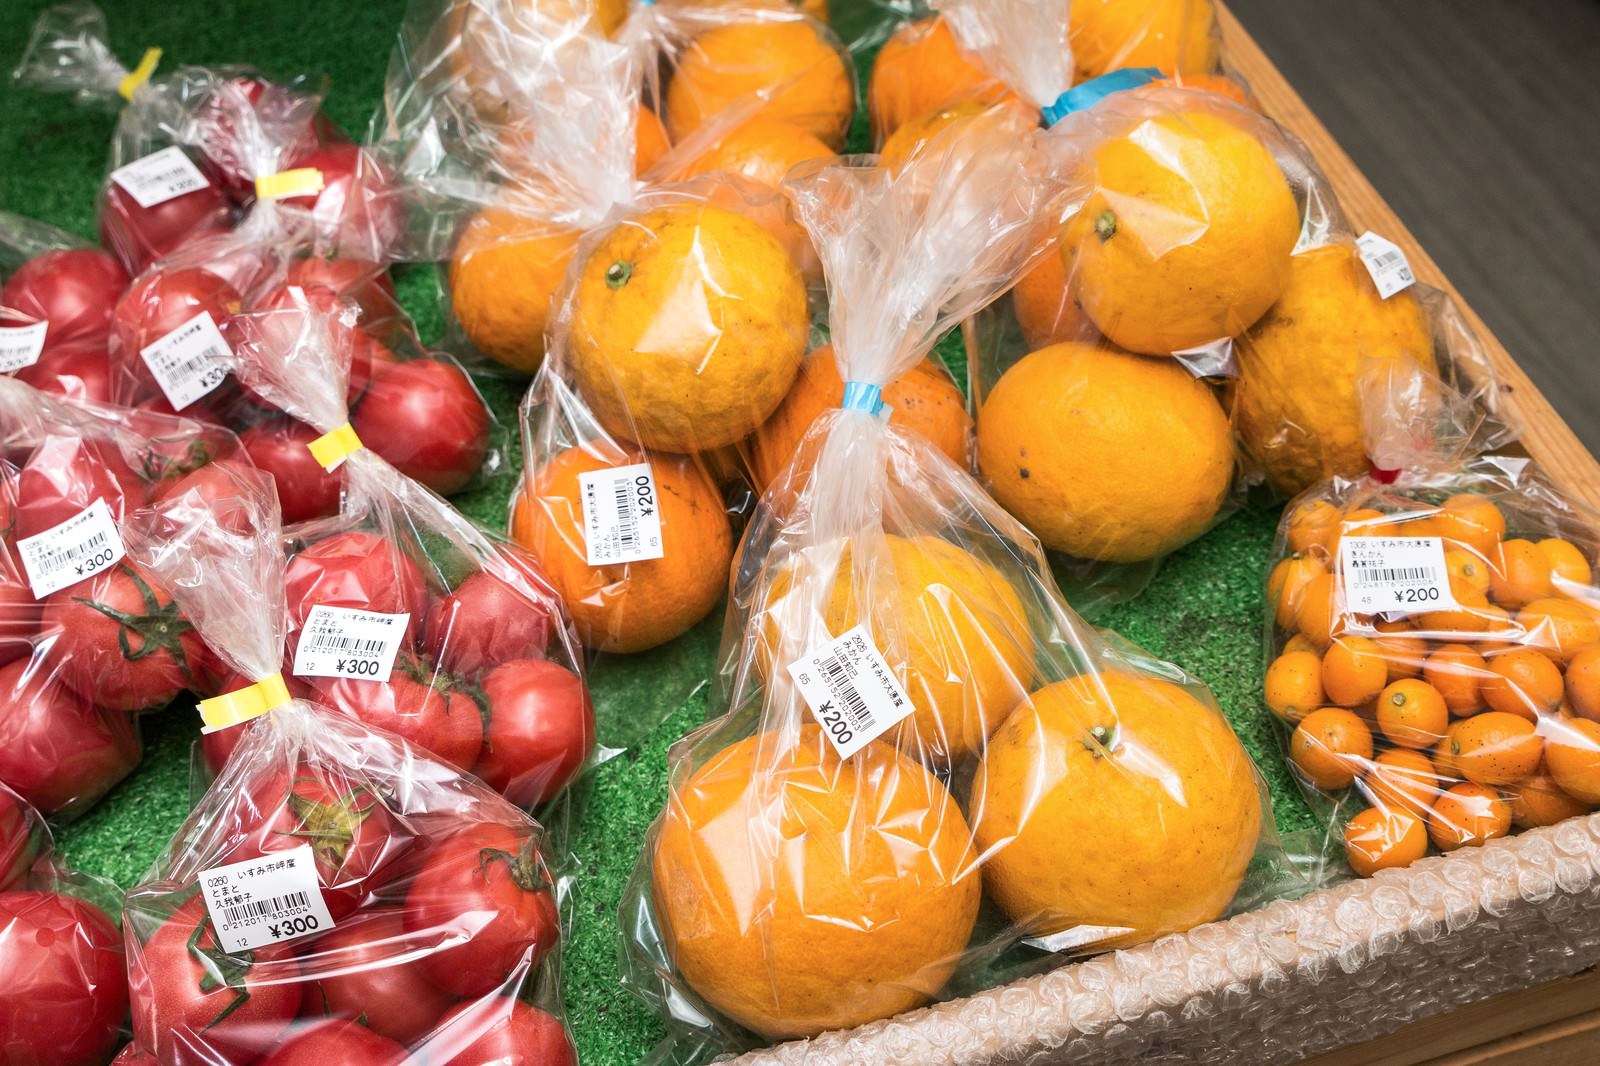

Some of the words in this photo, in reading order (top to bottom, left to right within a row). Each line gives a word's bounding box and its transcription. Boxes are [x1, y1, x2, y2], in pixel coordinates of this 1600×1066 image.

[635, 476, 653, 517] ¥200
[603, 534, 611, 558] みかん
[650, 537, 658, 546] 65
[75, 548, 113, 575] ¥300
[1394, 587, 1439, 602] ¥200
[843, 641, 862, 666] みかん
[336, 659, 379, 676] ¥300
[799, 672, 811, 684] 65
[819, 700, 853, 744] ¥200
[237, 858, 296, 879] いすみ市岬産
[212, 884, 239, 898] とまと
[268, 915, 318, 939] ¥300
[237, 938, 248, 947] 12
